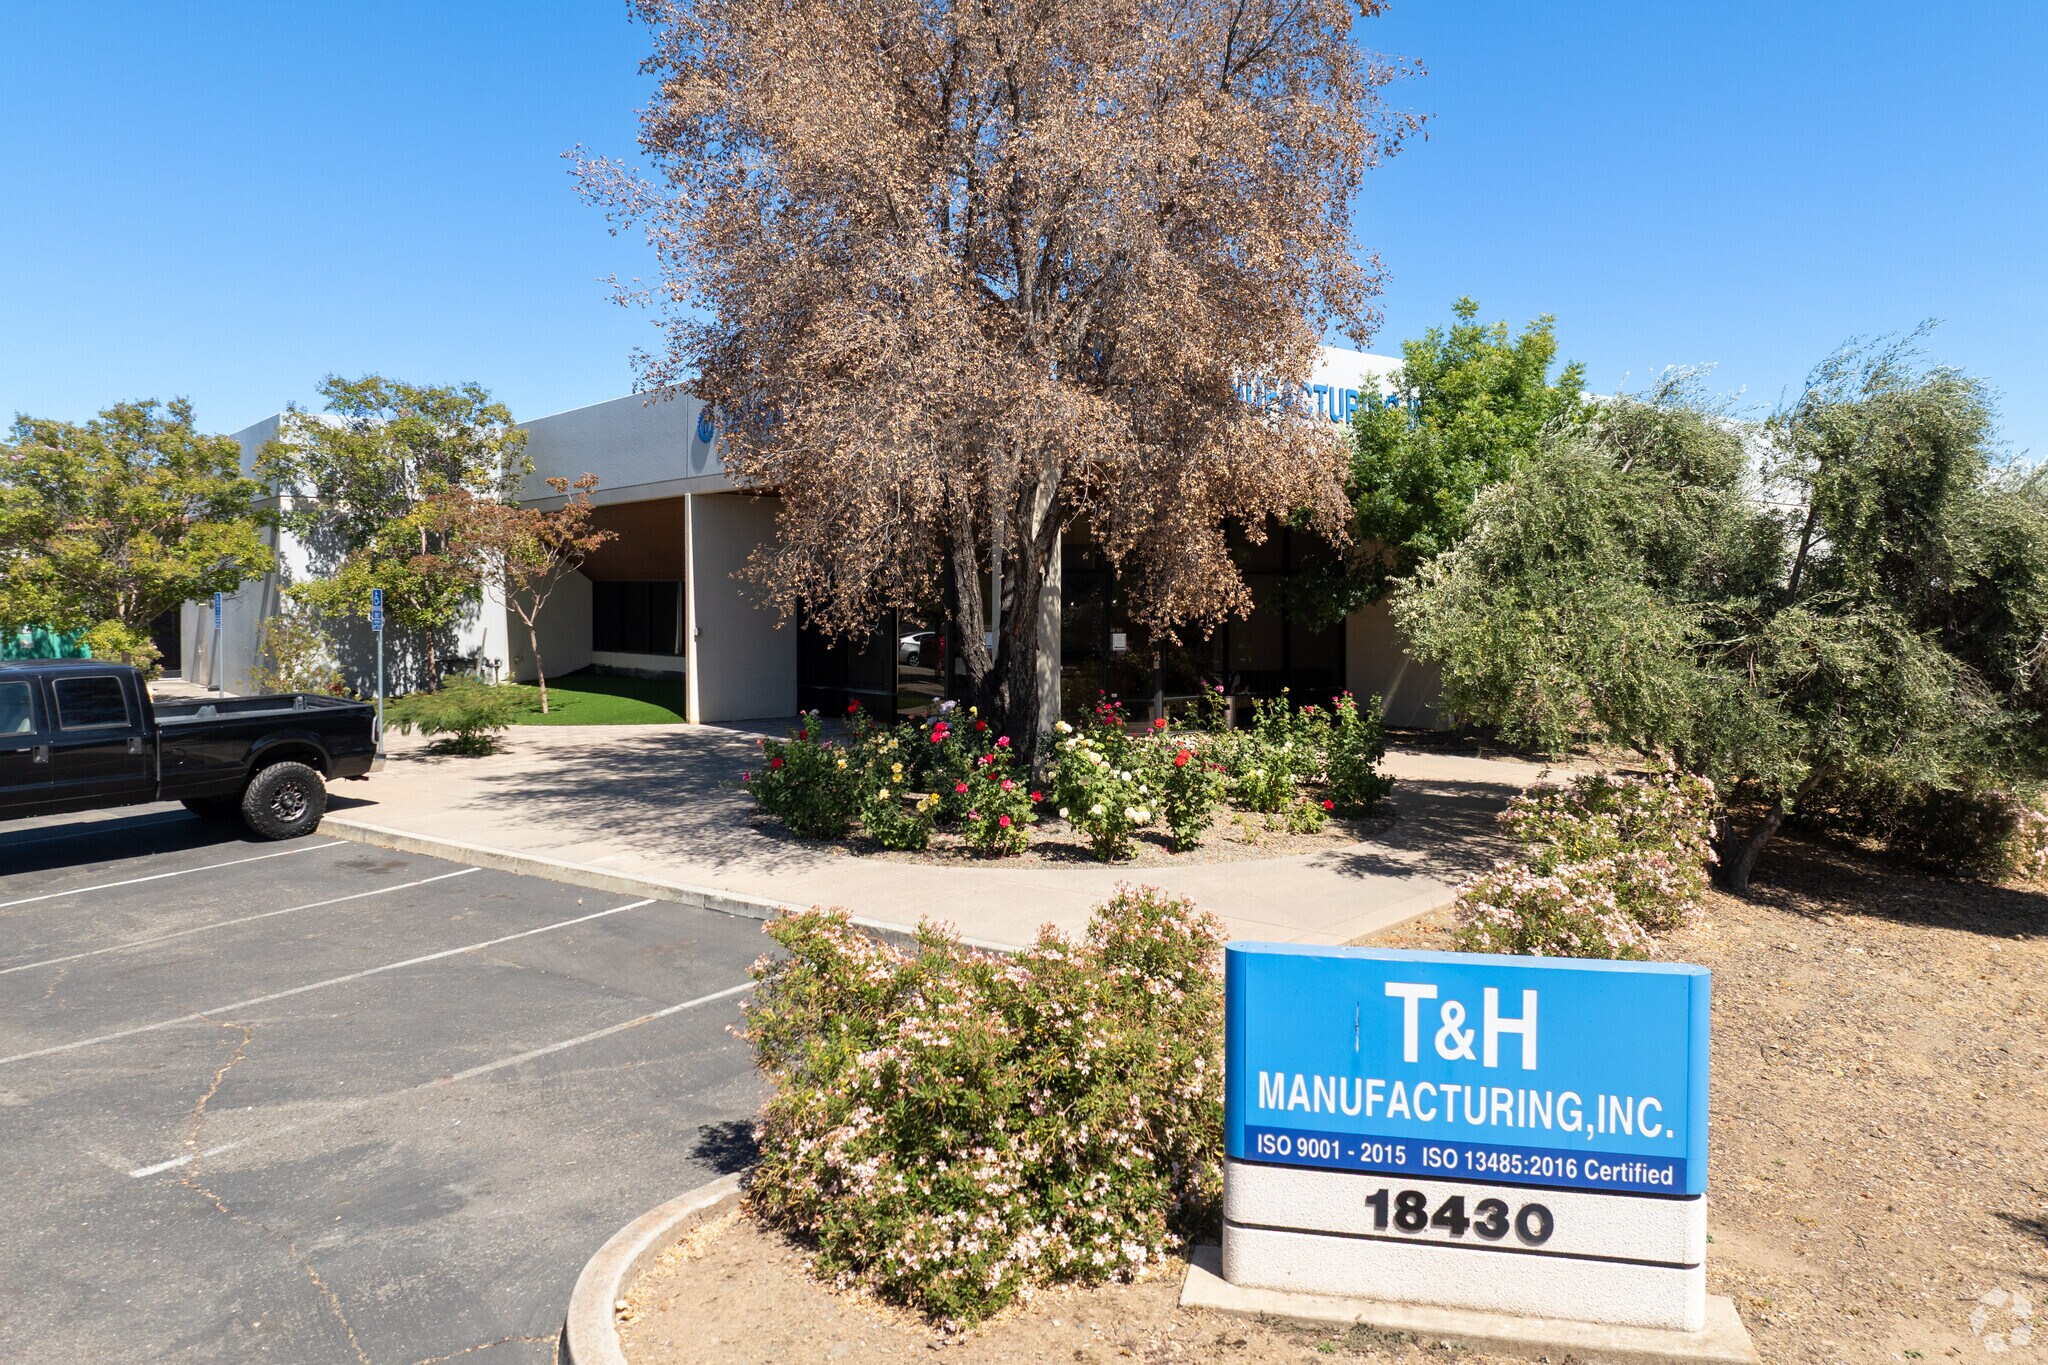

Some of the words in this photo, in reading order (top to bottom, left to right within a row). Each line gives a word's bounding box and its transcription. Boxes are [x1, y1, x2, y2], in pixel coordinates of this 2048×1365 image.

[1385, 981, 1538, 1070] T&H
[1257, 1134, 1291, 1155] ISO
[1297, 1137, 1340, 1160] 9001
[1360, 1143, 1406, 1165] 2015
[1422, 1147, 1458, 1169] ISO
[1464, 1150, 1578, 1179] 13485:2016
[1584, 1159, 1674, 1185] Certified
[1366, 1188, 1554, 1245] 18430
